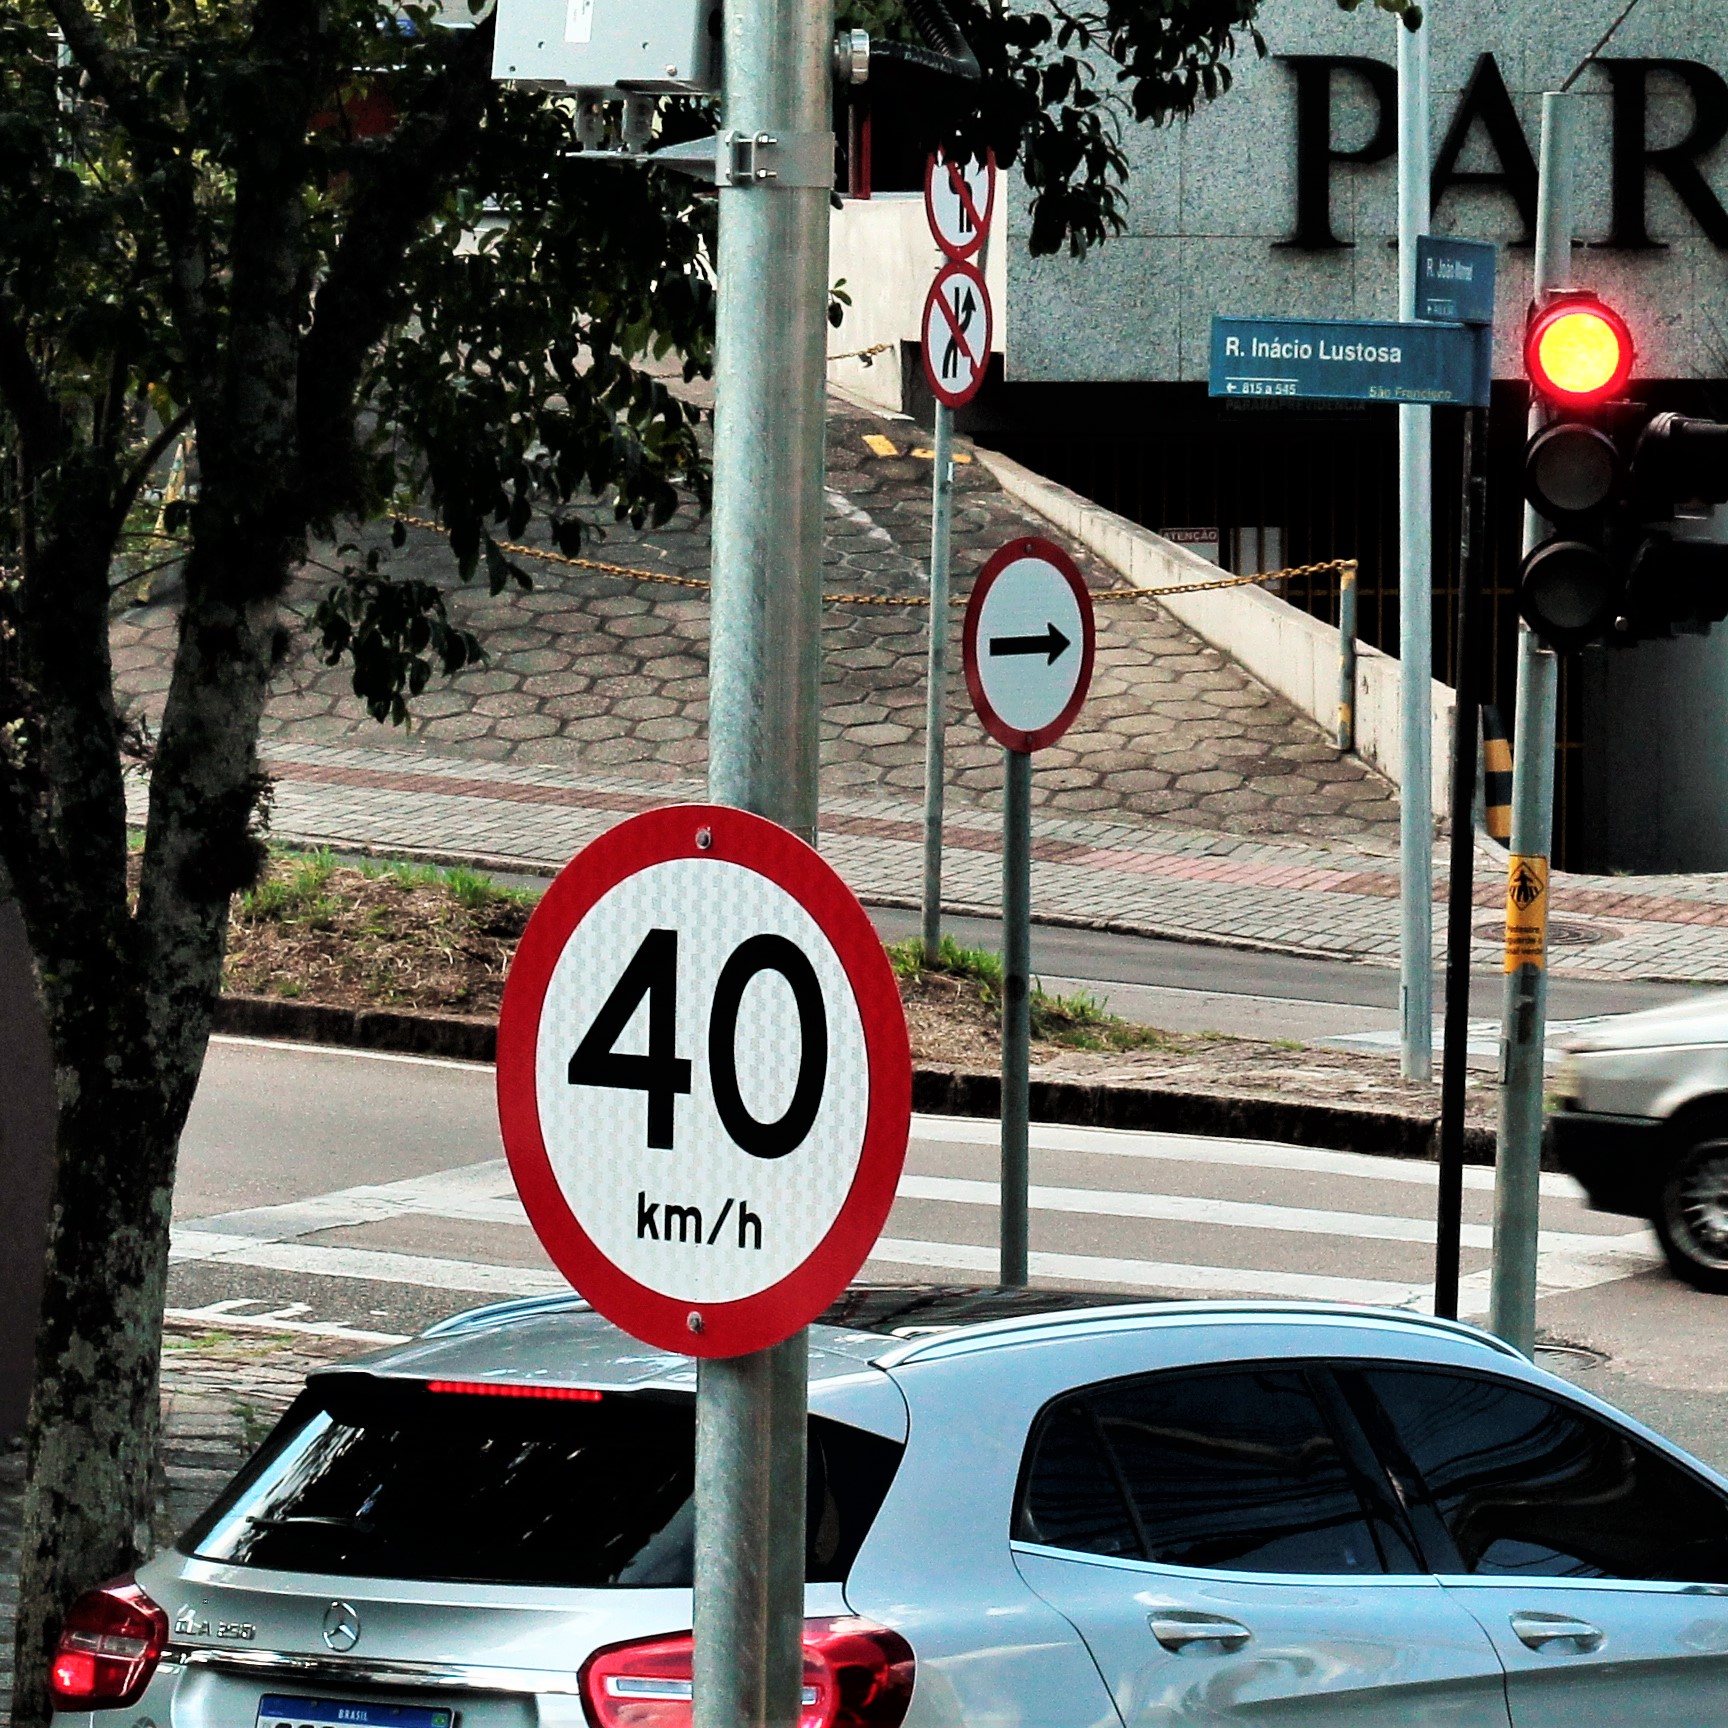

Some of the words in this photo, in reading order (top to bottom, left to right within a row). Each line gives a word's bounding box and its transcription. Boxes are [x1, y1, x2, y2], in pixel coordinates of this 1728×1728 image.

[1225, 336, 1245, 357] R.
[1252, 337, 1312, 359] Inácio
[1319, 340, 1402, 363] Lustosa
[1265, 385, 1273, 395] a
[1275, 383, 1297, 396] 545
[1369, 385, 1391, 398] São
[1395, 386, 1453, 400] Francisco
[567, 928, 828, 1160] 40
[637, 1190, 763, 1251] km/h
[337, 1708, 369, 1722] BRASIL
